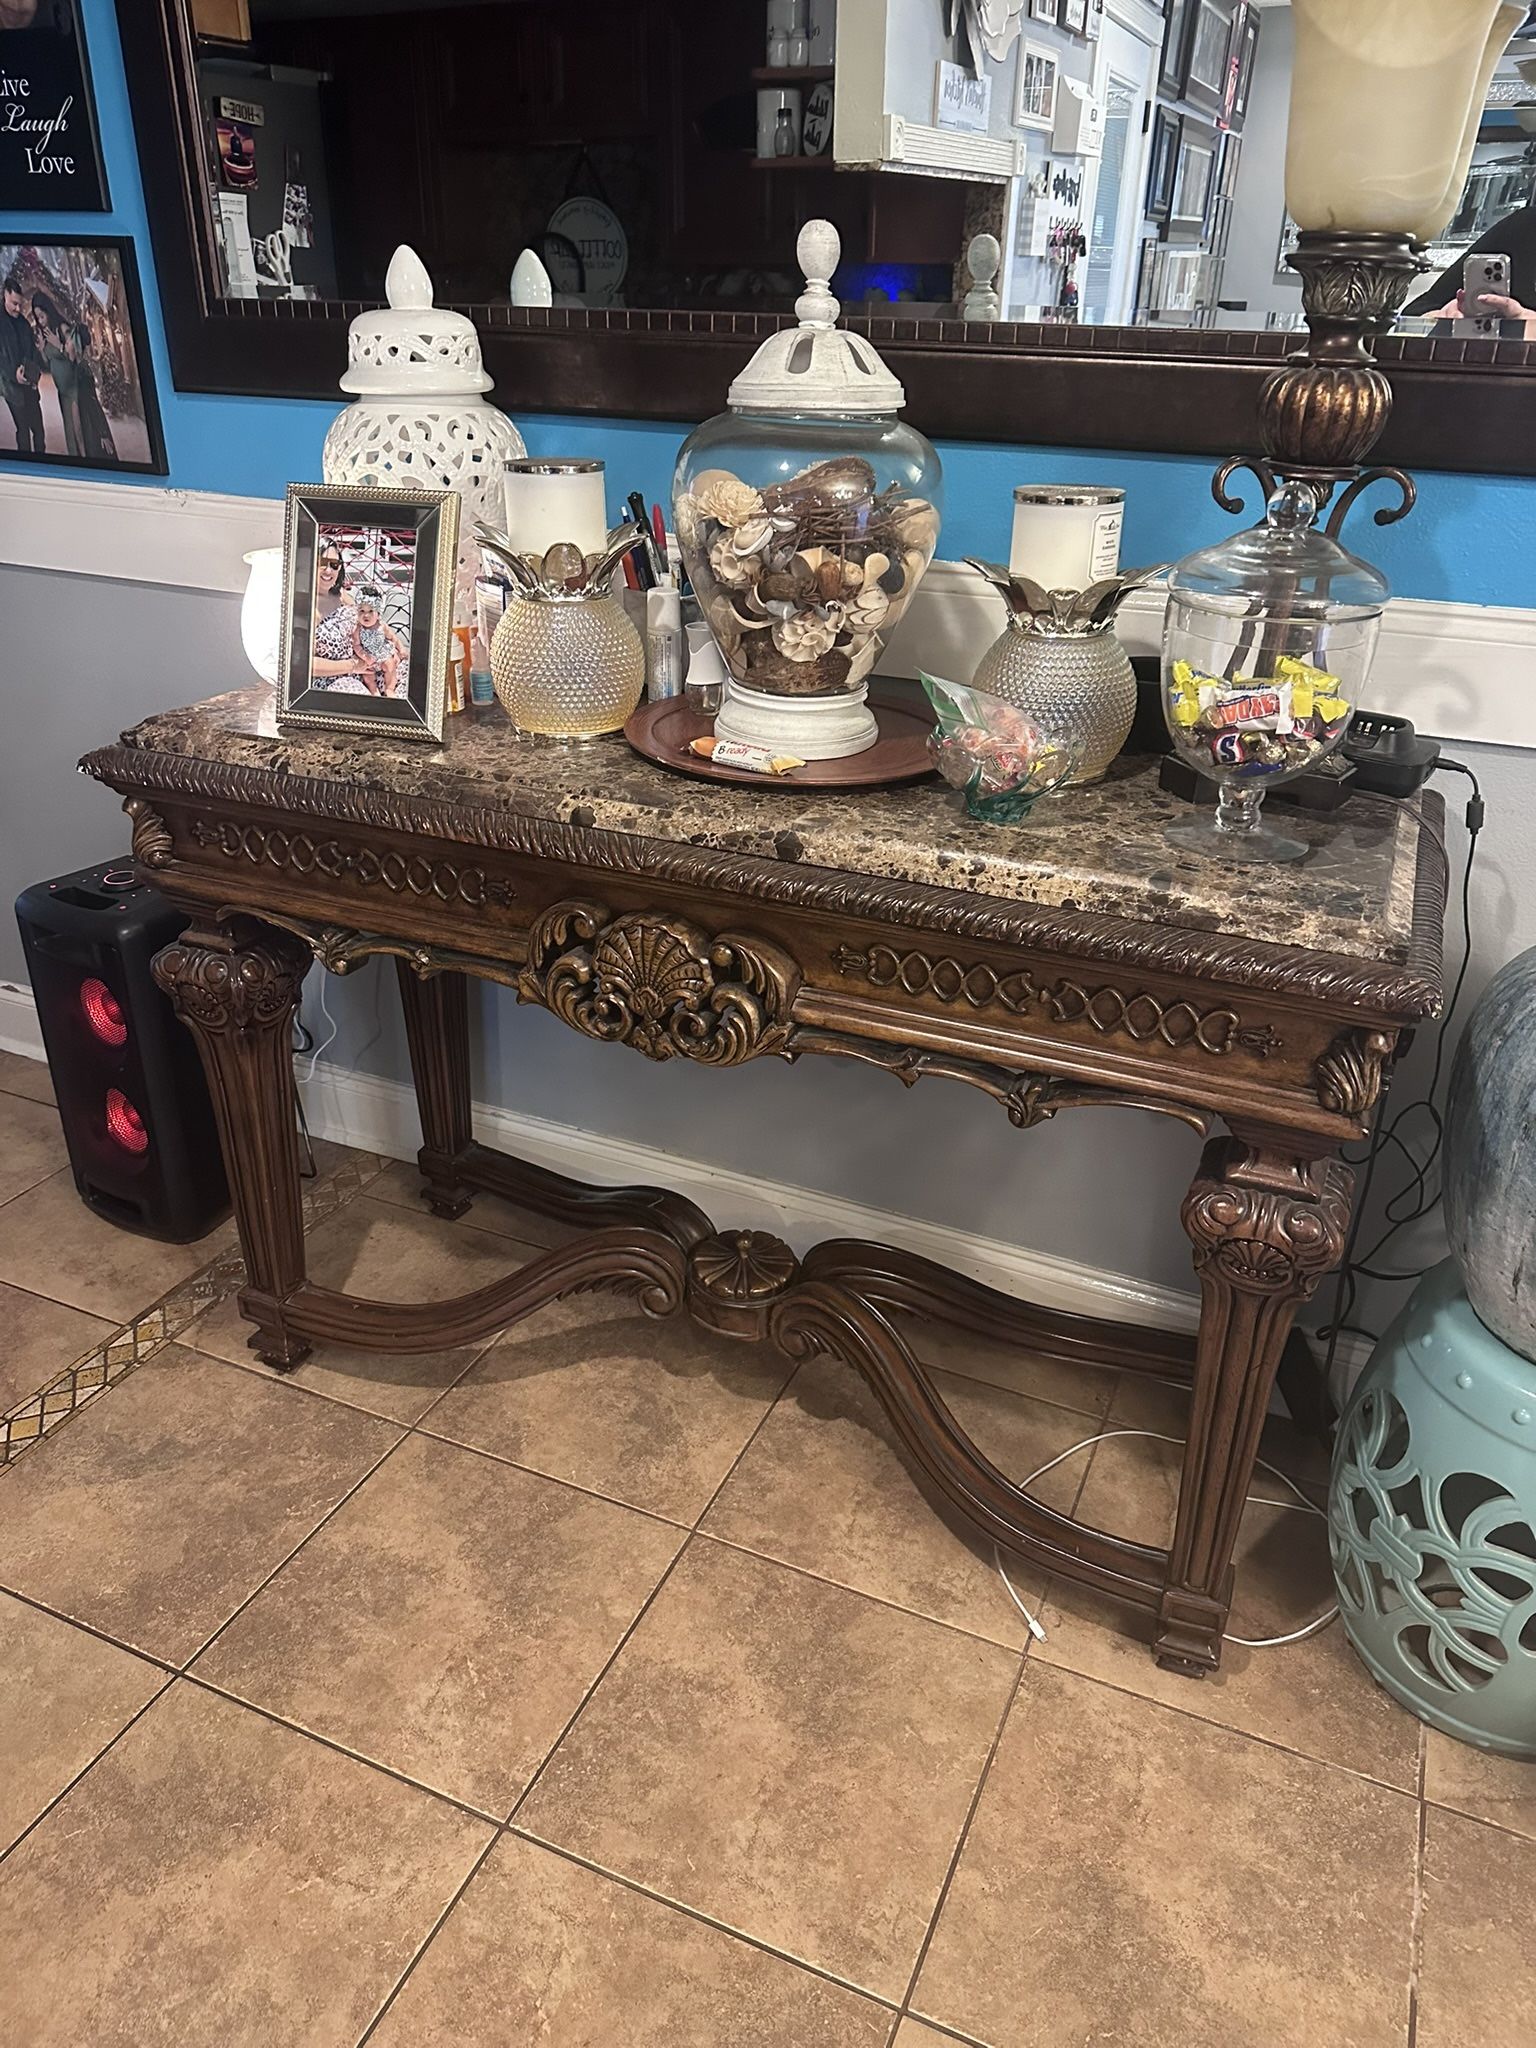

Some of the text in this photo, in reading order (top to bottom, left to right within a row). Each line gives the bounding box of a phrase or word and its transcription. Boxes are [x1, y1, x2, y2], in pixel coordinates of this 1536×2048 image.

[1, 95, 73, 155] Laugh
[24, 147, 76, 175] Love
[1217, 694, 1279, 725] AYDA
[726, 747, 750, 757] ready
